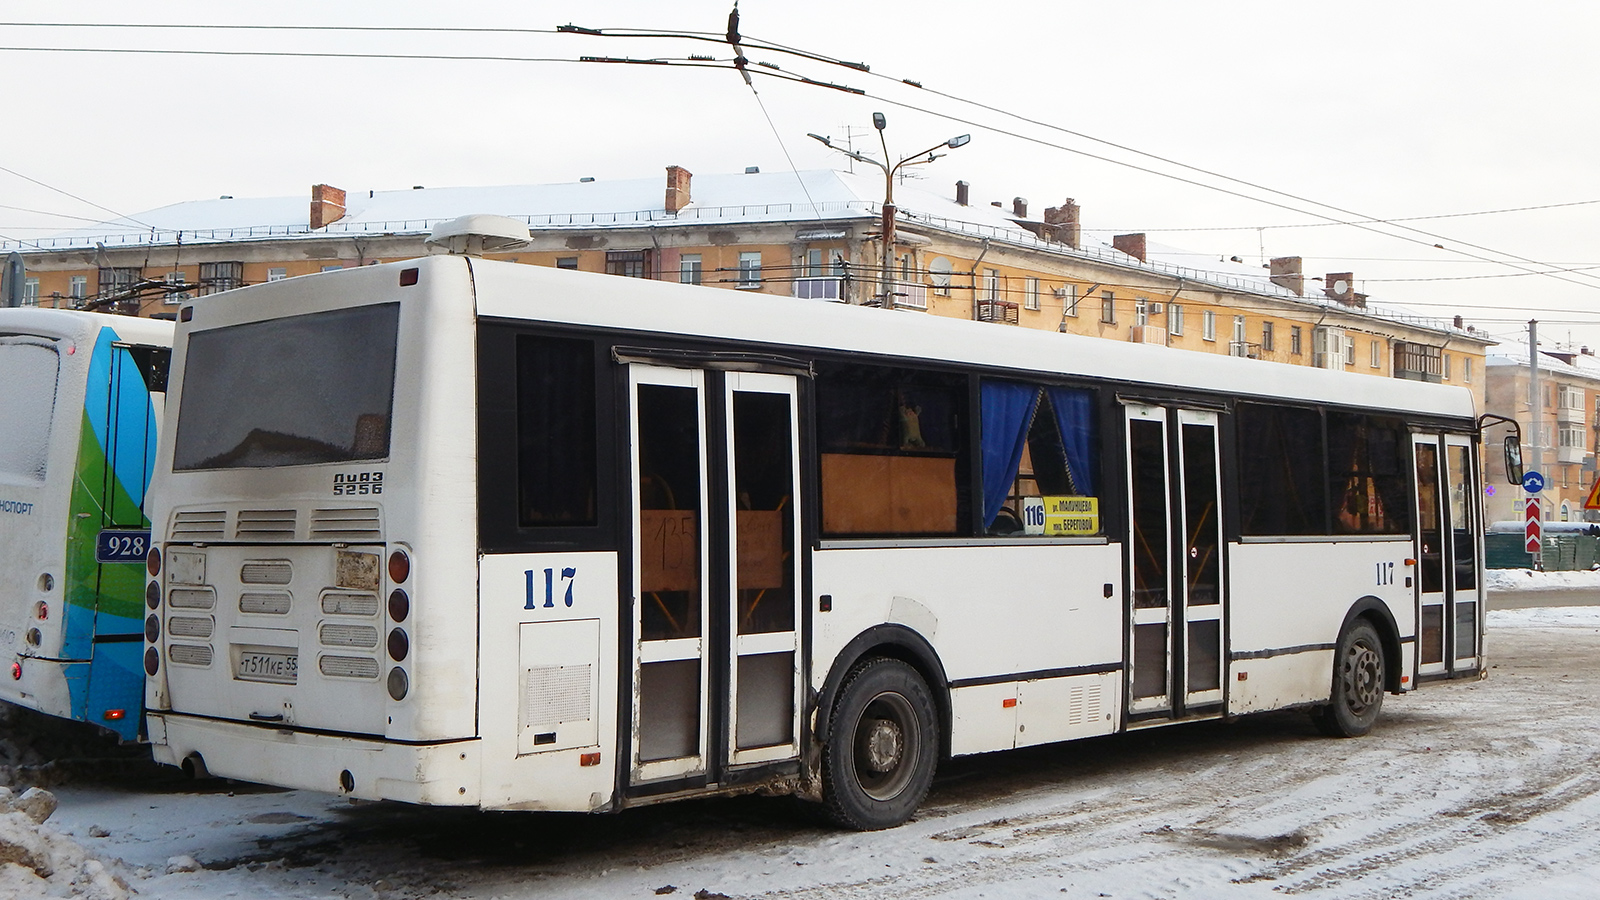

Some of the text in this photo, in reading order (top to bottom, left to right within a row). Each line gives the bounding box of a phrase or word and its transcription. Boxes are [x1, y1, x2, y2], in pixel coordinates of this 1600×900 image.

[334, 484, 382, 495] 5256
[0, 500, 33, 515] НСПОРТ
[1025, 505, 1044, 526] 116
[1063, 517, 1093, 531] БЕРЕГОВОЙ
[108, 536, 144, 556] 928
[1376, 562, 1394, 586] 117
[523, 566, 577, 611] 117
[244, 656, 297, 675] Т511КЕ 55
